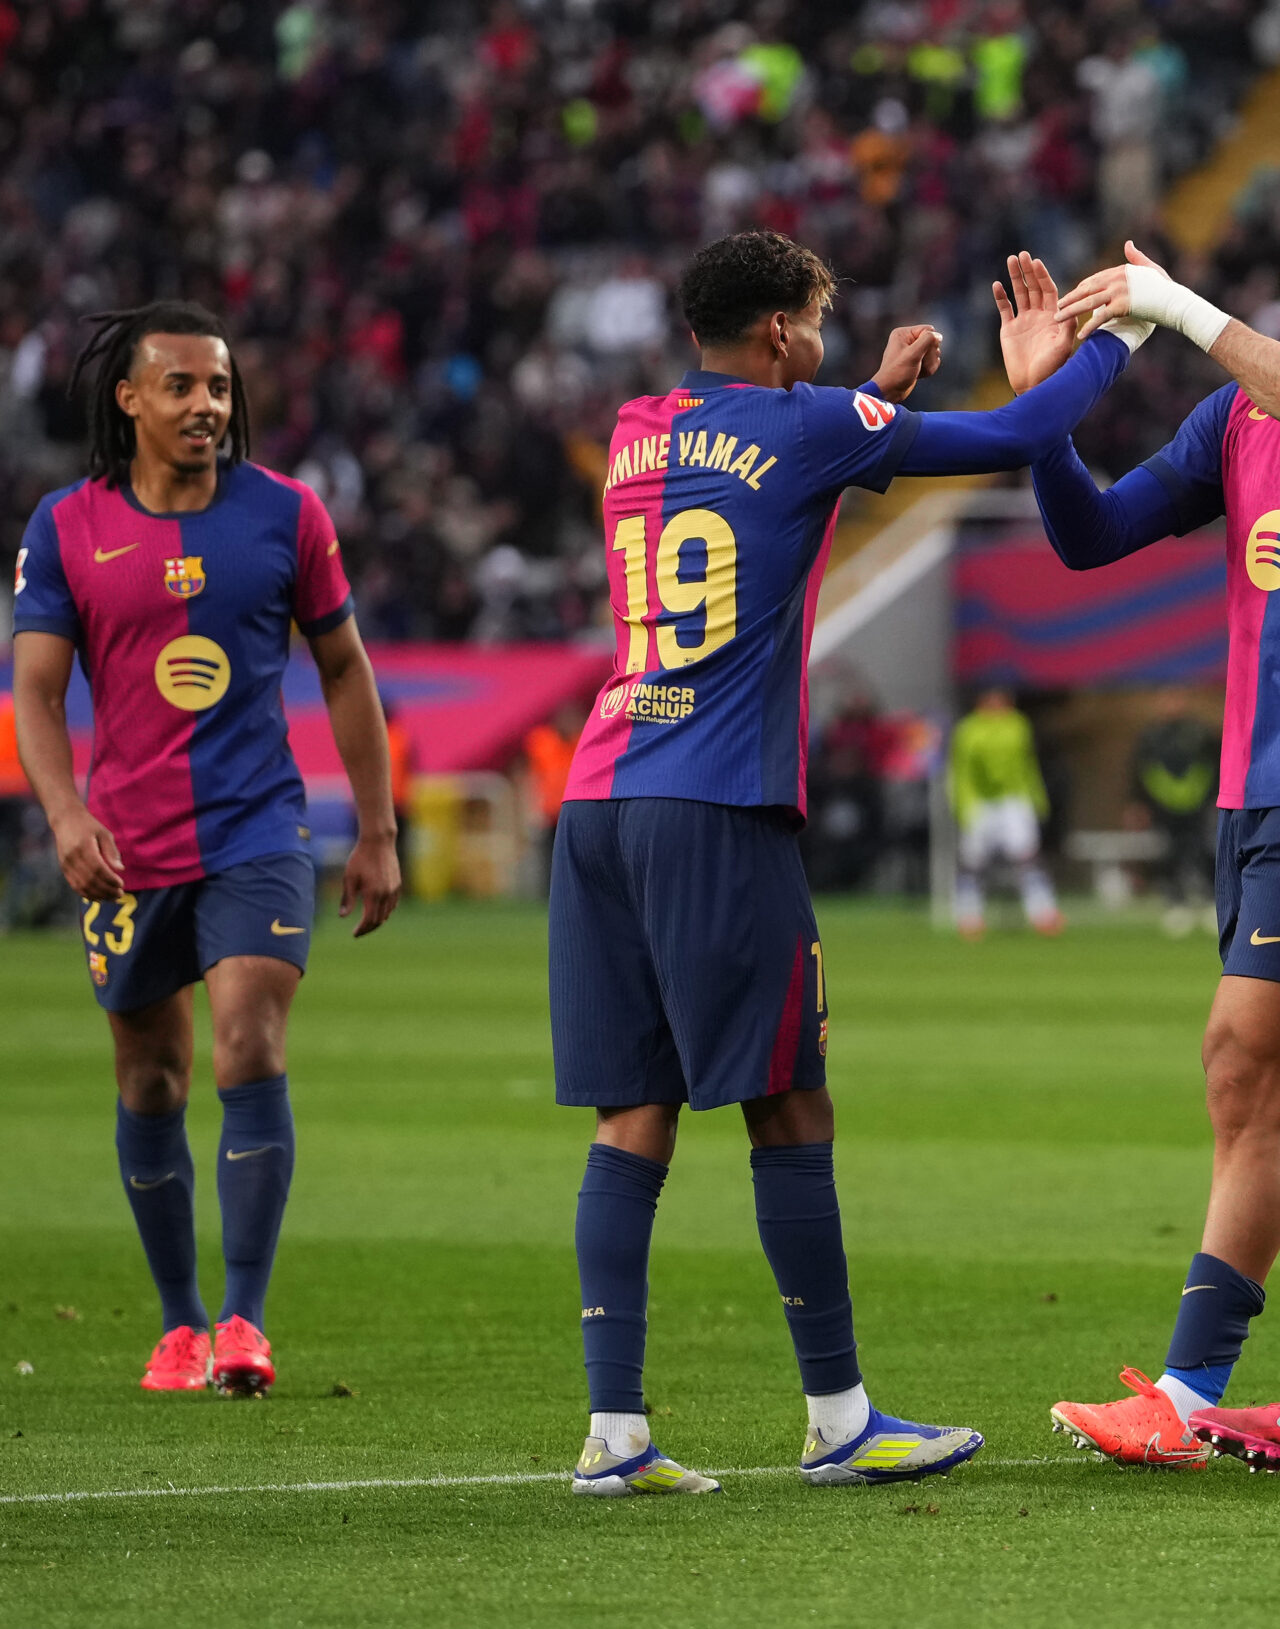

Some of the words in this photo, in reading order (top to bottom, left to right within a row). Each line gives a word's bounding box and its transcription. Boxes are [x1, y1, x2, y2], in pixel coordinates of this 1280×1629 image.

[679, 431, 778, 491] YAMAL
[612, 508, 737, 675] 19
[630, 683, 695, 703] UNHCR
[82, 893, 138, 955] 23
[811, 941, 824, 1012] 1
